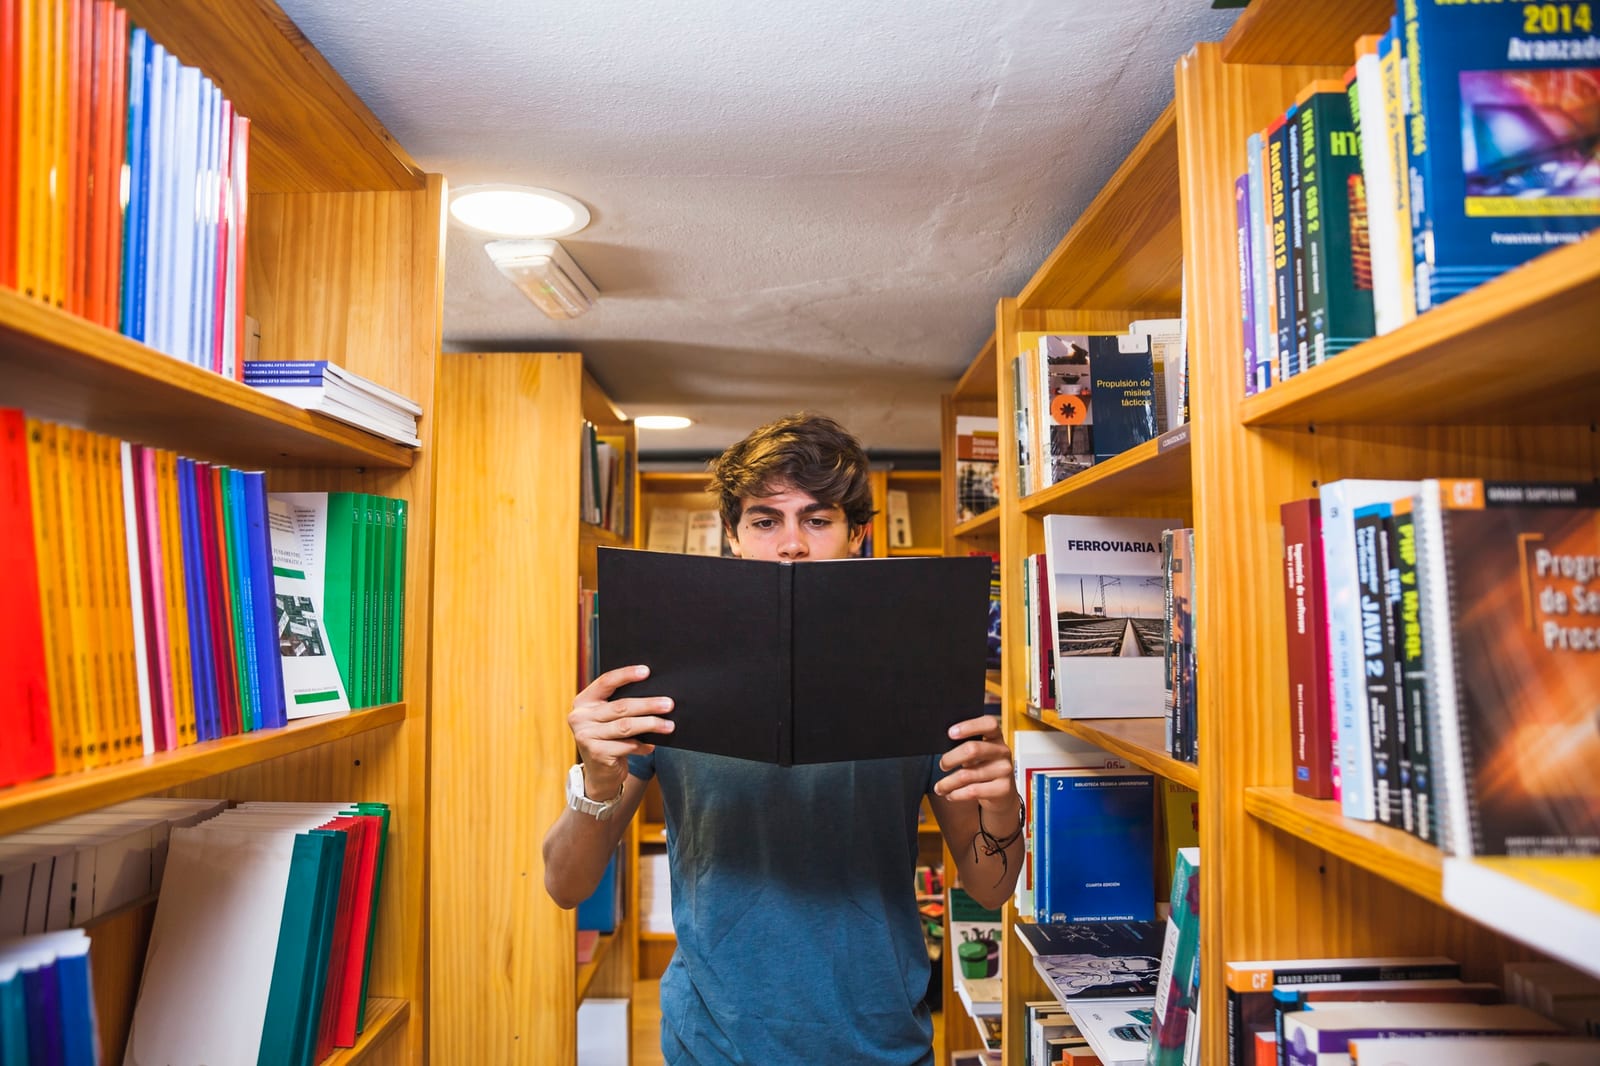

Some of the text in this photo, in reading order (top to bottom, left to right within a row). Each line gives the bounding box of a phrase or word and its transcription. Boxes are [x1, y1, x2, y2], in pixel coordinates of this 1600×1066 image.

[1523, 4, 1593, 34] 2014
[1270, 141, 1286, 218] AutoCAD
[1096, 379, 1151, 389] Propulsión de
[1123, 389, 1152, 397] misiles
[1121, 398, 1152, 407] tácticos
[1454, 482, 1475, 506] CF
[1067, 540, 1156, 553] FERROVIARIA
[1296, 585, 1304, 596] de
[1399, 524, 1421, 662] PHP y MySQL
[1540, 585, 1568, 614] de
[1297, 597, 1306, 634] software
[1361, 595, 1383, 656] JAVA
[1365, 659, 1385, 678] 2
[1056, 780, 1064, 791] 2
[1158, 926, 1178, 1018] MATERIALES
[1252, 972, 1342, 989] CF GRADO SUPERIOR
